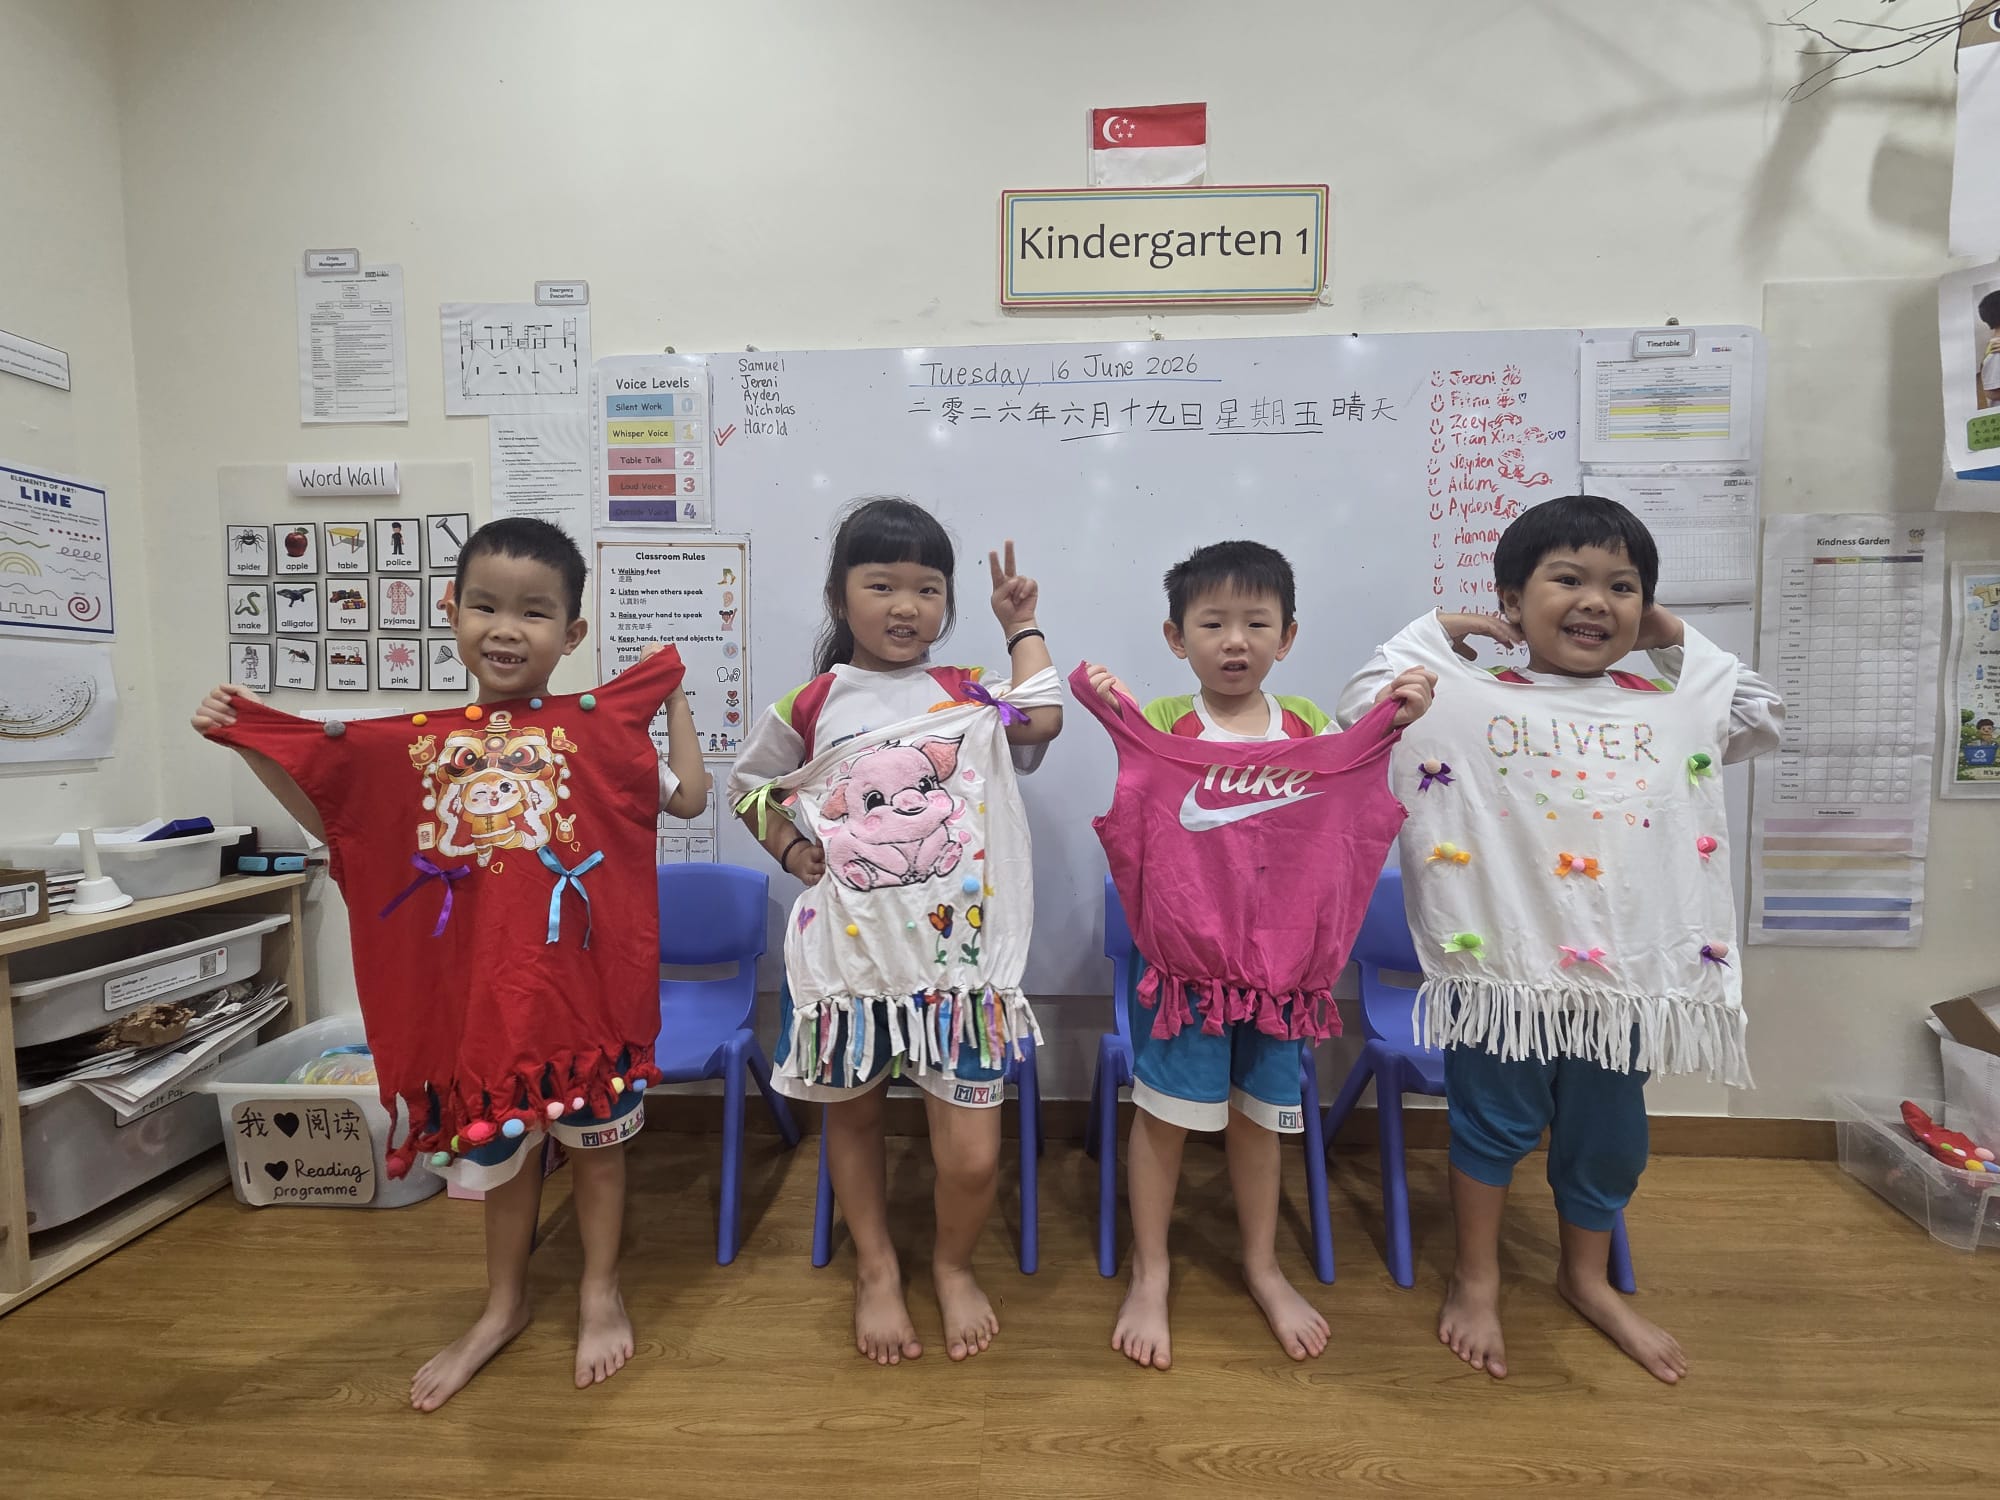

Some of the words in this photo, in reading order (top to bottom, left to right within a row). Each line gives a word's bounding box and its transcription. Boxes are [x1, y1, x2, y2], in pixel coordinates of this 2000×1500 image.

[1020, 224, 1282, 269] Kindergarten
[1296, 228, 1309, 255] 1
[1646, 339, 1681, 348] Timetable
[738, 358, 785, 373] Samuel
[920, 360, 1030, 395] Tuesday
[1051, 360, 1070, 382] 16
[1084, 354, 1134, 378] June
[1146, 354, 1198, 375] 2026
[616, 379, 648, 390] Voice
[652, 377, 690, 389] Levels
[740, 374, 779, 390] Jereni
[743, 389, 780, 405] Ayden
[615, 403, 638, 411] Silent
[641, 402, 663, 410] Work
[681, 397, 694, 413] 0
[746, 402, 796, 417] Nicholas
[613, 429, 645, 439] Whisper
[648, 429, 669, 437] Voice
[683, 424, 694, 440] 1
[744, 418, 788, 436] Harold
[620, 456, 642, 464] Table
[646, 456, 663, 464] Talk
[683, 451, 695, 466] 2
[10, 474, 47, 488] ELEMENTS
[299, 467, 342, 488] Word
[346, 467, 385, 487] Wall
[642, 482, 663, 490] Voice
[683, 477, 696, 493] 3
[20, 486, 72, 508] LINE
[683, 502, 697, 519] 4
[1816, 538, 1857, 546] Kindness
[1858, 537, 1891, 546] Garden
[386, 558, 412, 567] police
[636, 552, 681, 561] Classroom
[683, 553, 706, 561] Rules
[237, 563, 260, 571] spider
[286, 562, 309, 571] apple
[338, 561, 358, 569] table
[618, 568, 646, 576] Walking
[618, 588, 640, 596] Listen
[683, 589, 704, 597] speak
[340, 616, 356, 625] toys
[383, 617, 416, 626] pyjamas
[618, 611, 638, 619] Raise
[638, 612, 654, 621] your
[683, 612, 703, 620] speak
[237, 622, 261, 630] snake
[281, 619, 314, 629] alligator
[618, 635, 636, 643] Keep
[637, 635, 659, 643] hands,
[689, 635, 714, 643] objects
[616, 645, 642, 654] yoursel
[289, 676, 302, 684] ant
[339, 678, 356, 687] train
[391, 676, 408, 685] pink
[1487, 714, 1661, 764] OLIVER
[237, 1106, 269, 1138] 我
[305, 1107, 361, 1141] 阅读
[244, 1161, 251, 1184] I
[294, 1158, 370, 1184] Reading
[273, 1184, 358, 1201] programme
